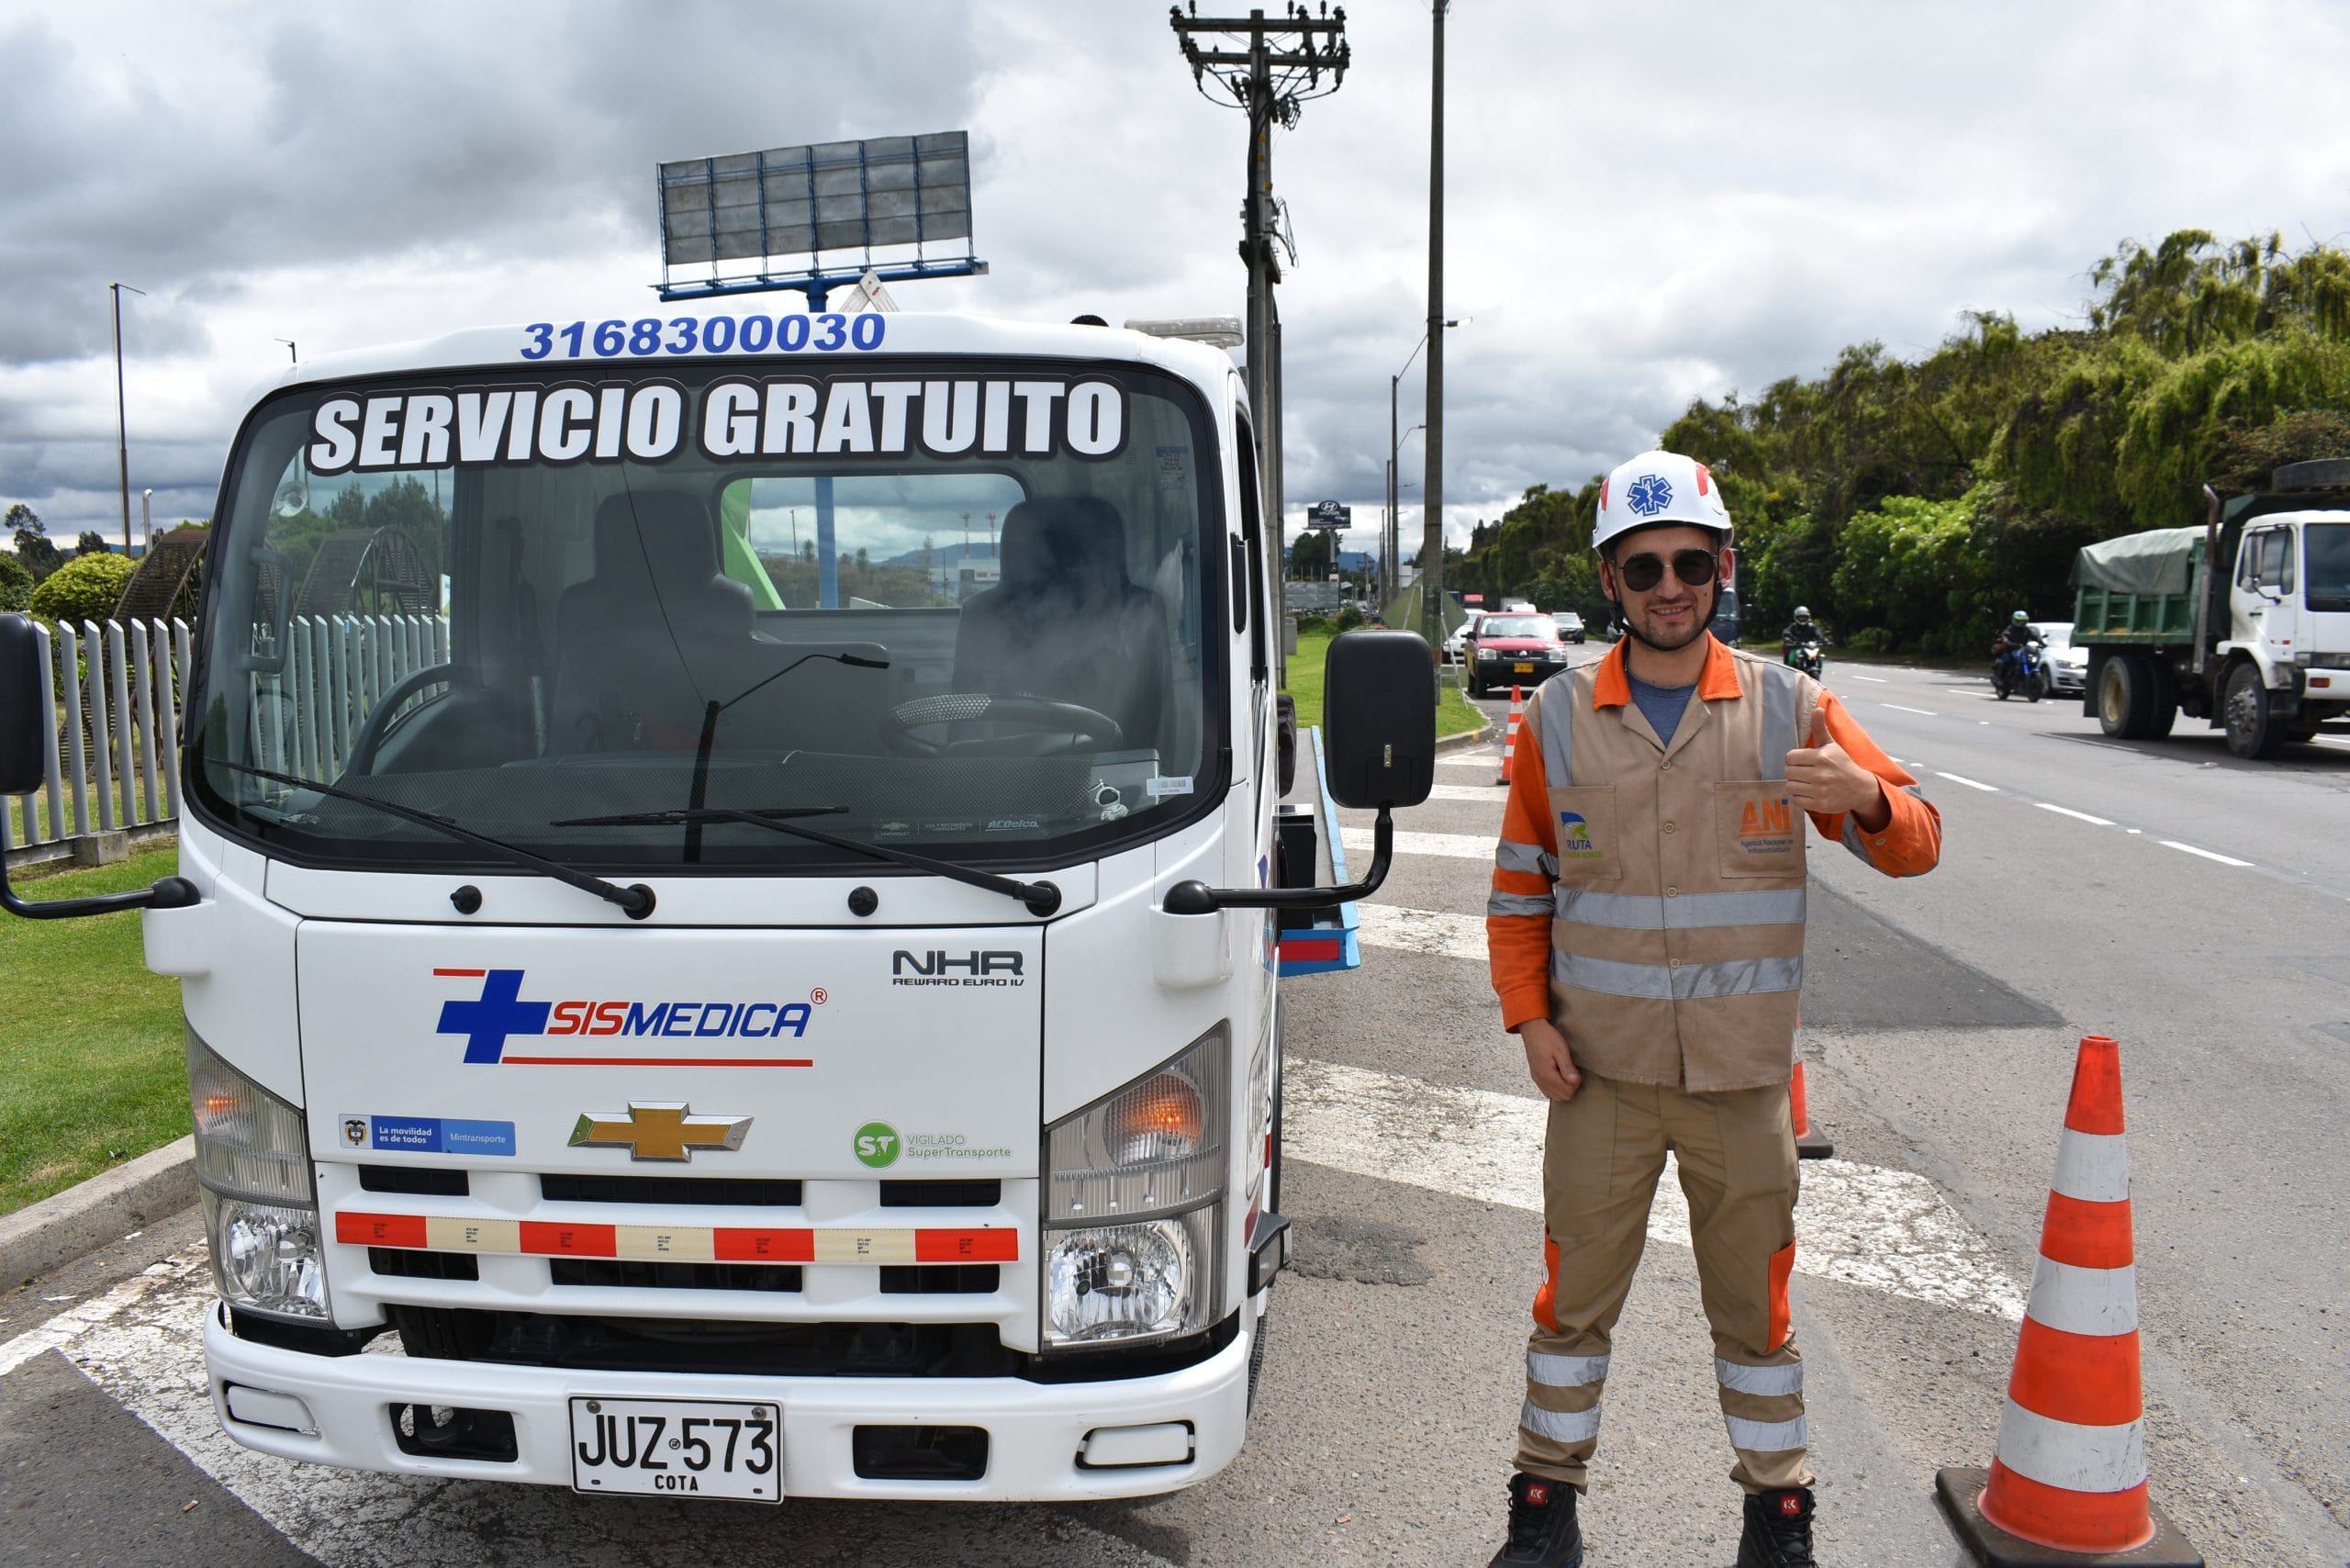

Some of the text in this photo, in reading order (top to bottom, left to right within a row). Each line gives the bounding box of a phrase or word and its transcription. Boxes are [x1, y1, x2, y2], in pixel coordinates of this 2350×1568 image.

[520, 313, 886, 360] 3168300030
[310, 381, 1122, 470] SERVICIO GRATUITO
[1567, 839, 1593, 850] RUTA
[892, 950, 1024, 976] NHR
[892, 978, 1025, 987] REWARD EURO IV
[547, 1001, 811, 1038] SISMEDICA
[379, 1126, 432, 1137] La movilidad
[390, 1135, 401, 1143] de
[403, 1136, 427, 1144] todos
[450, 1133, 507, 1145] Mintransporte
[906, 1135, 966, 1146] VIGILADO
[857, 1136, 896, 1157] ST
[907, 1148, 1012, 1159] SuperTransporte
[655, 1474, 699, 1492] COTA
